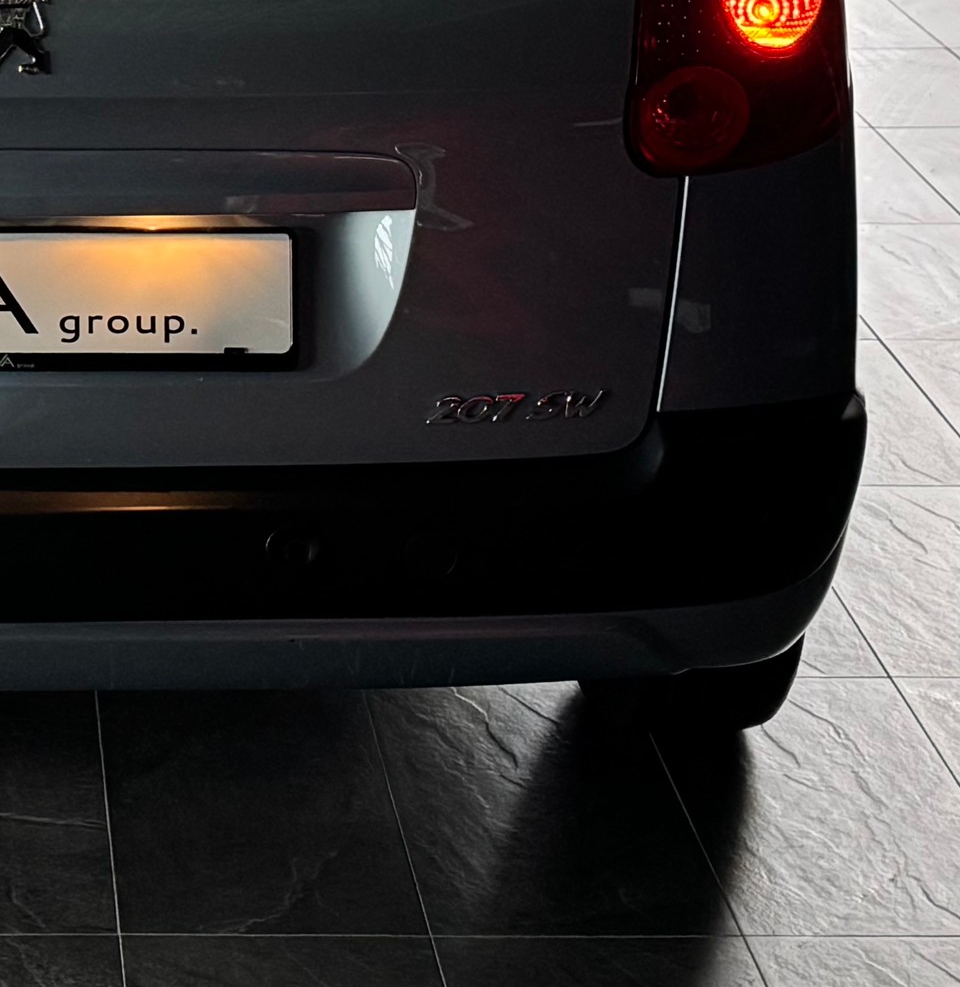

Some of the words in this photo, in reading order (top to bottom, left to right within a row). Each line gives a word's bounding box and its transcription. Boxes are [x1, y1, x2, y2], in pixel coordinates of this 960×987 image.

[59, 313, 198, 344] group.
[426, 392, 526, 424] 207
[526, 389, 607, 419] SW
